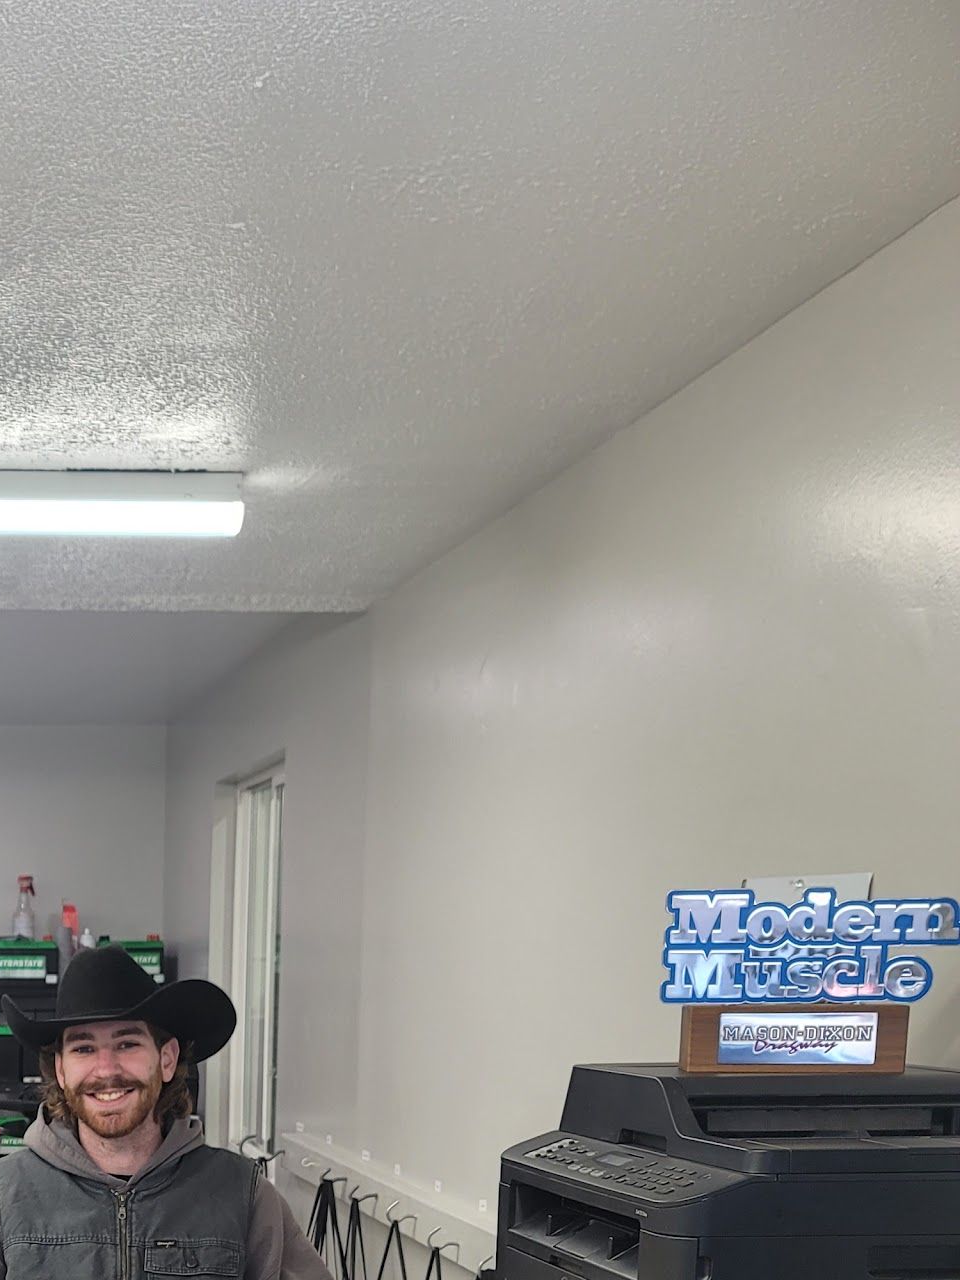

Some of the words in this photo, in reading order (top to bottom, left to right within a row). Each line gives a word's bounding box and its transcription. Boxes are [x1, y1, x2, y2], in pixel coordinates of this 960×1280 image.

[669, 891, 959, 943] Modern
[665, 945, 927, 998] Muscle
[722, 1025, 874, 1042] MASON-DIXON
[753, 1039, 839, 1055] Dragway
